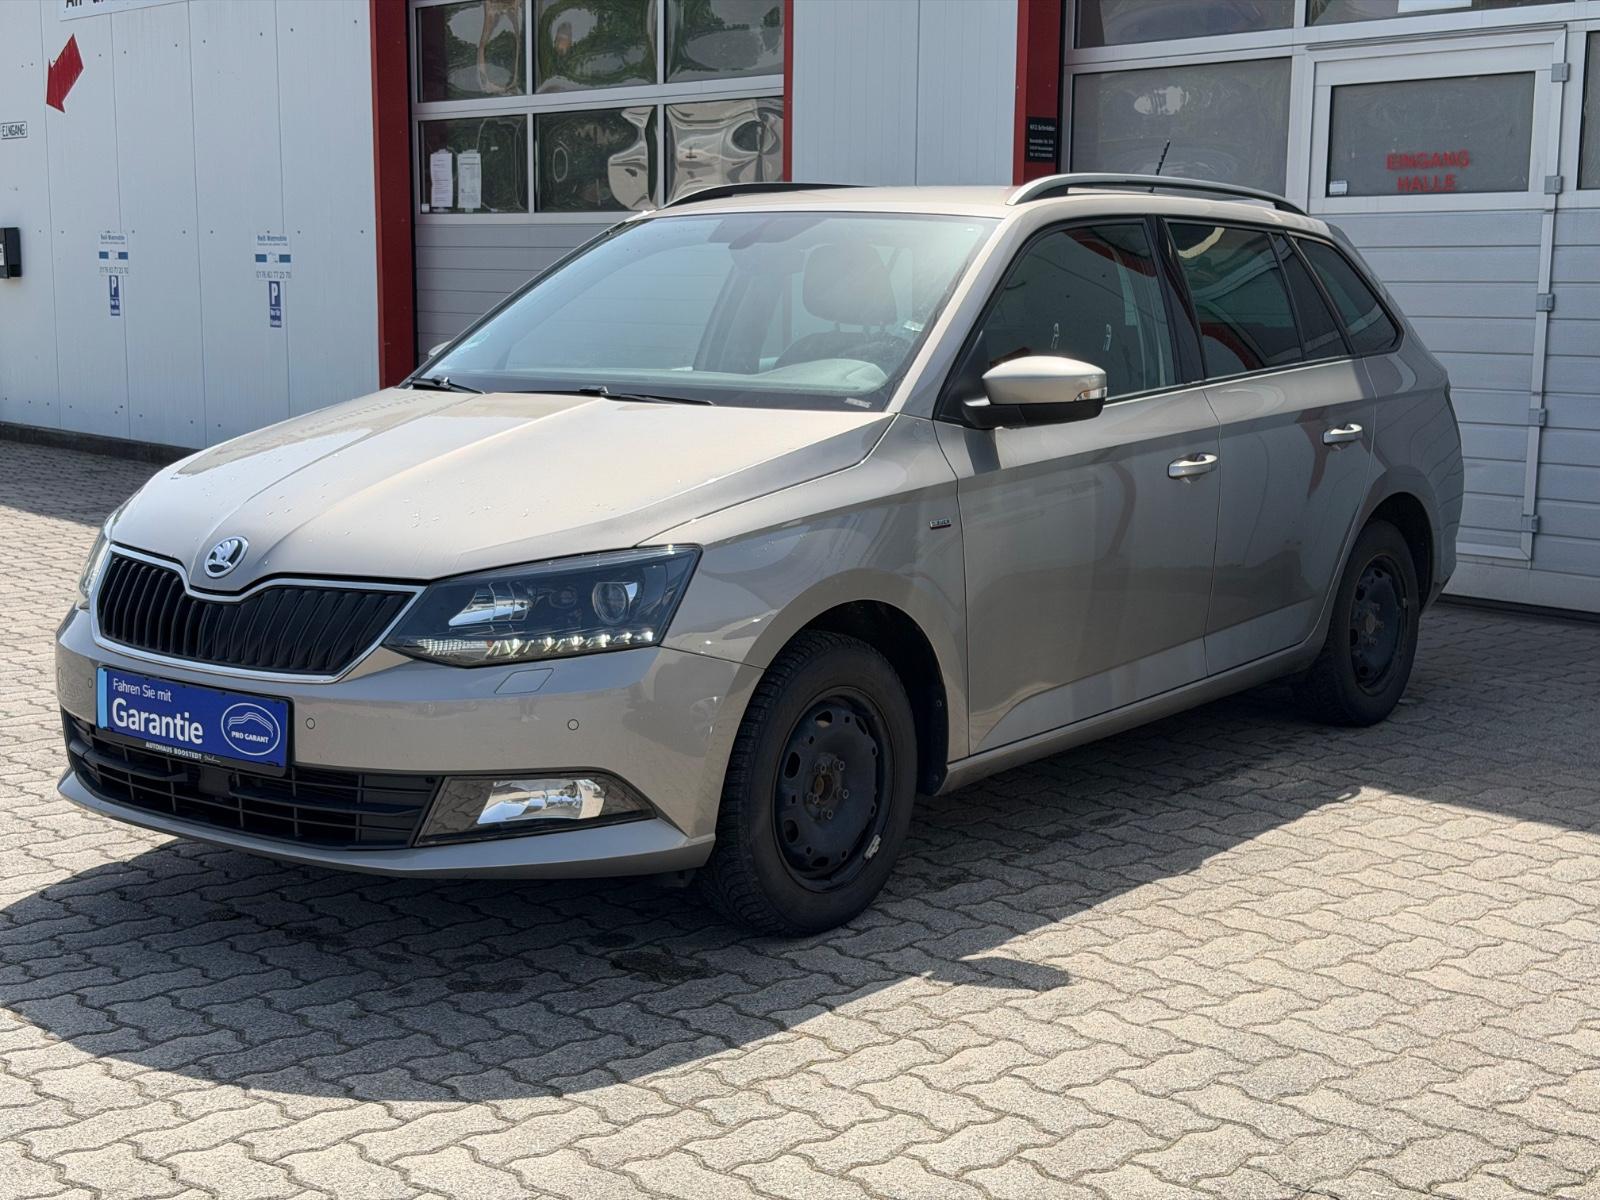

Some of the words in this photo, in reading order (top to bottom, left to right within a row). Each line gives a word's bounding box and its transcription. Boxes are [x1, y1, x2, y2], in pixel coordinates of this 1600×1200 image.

[1386, 149, 1470, 170] EINGANG
[1397, 174, 1457, 192] HALLE
[111, 276, 117, 296] P
[271, 283, 278, 305] P
[113, 678, 140, 695] Fahren
[142, 685, 155, 698] Sie
[157, 689, 171, 702] mit
[112, 697, 203, 744] Garantie
[231, 731, 244, 739] PRO
[145, 741, 173, 753] AUTOHAUS
[173, 748, 202, 760] BOOSTEDT
